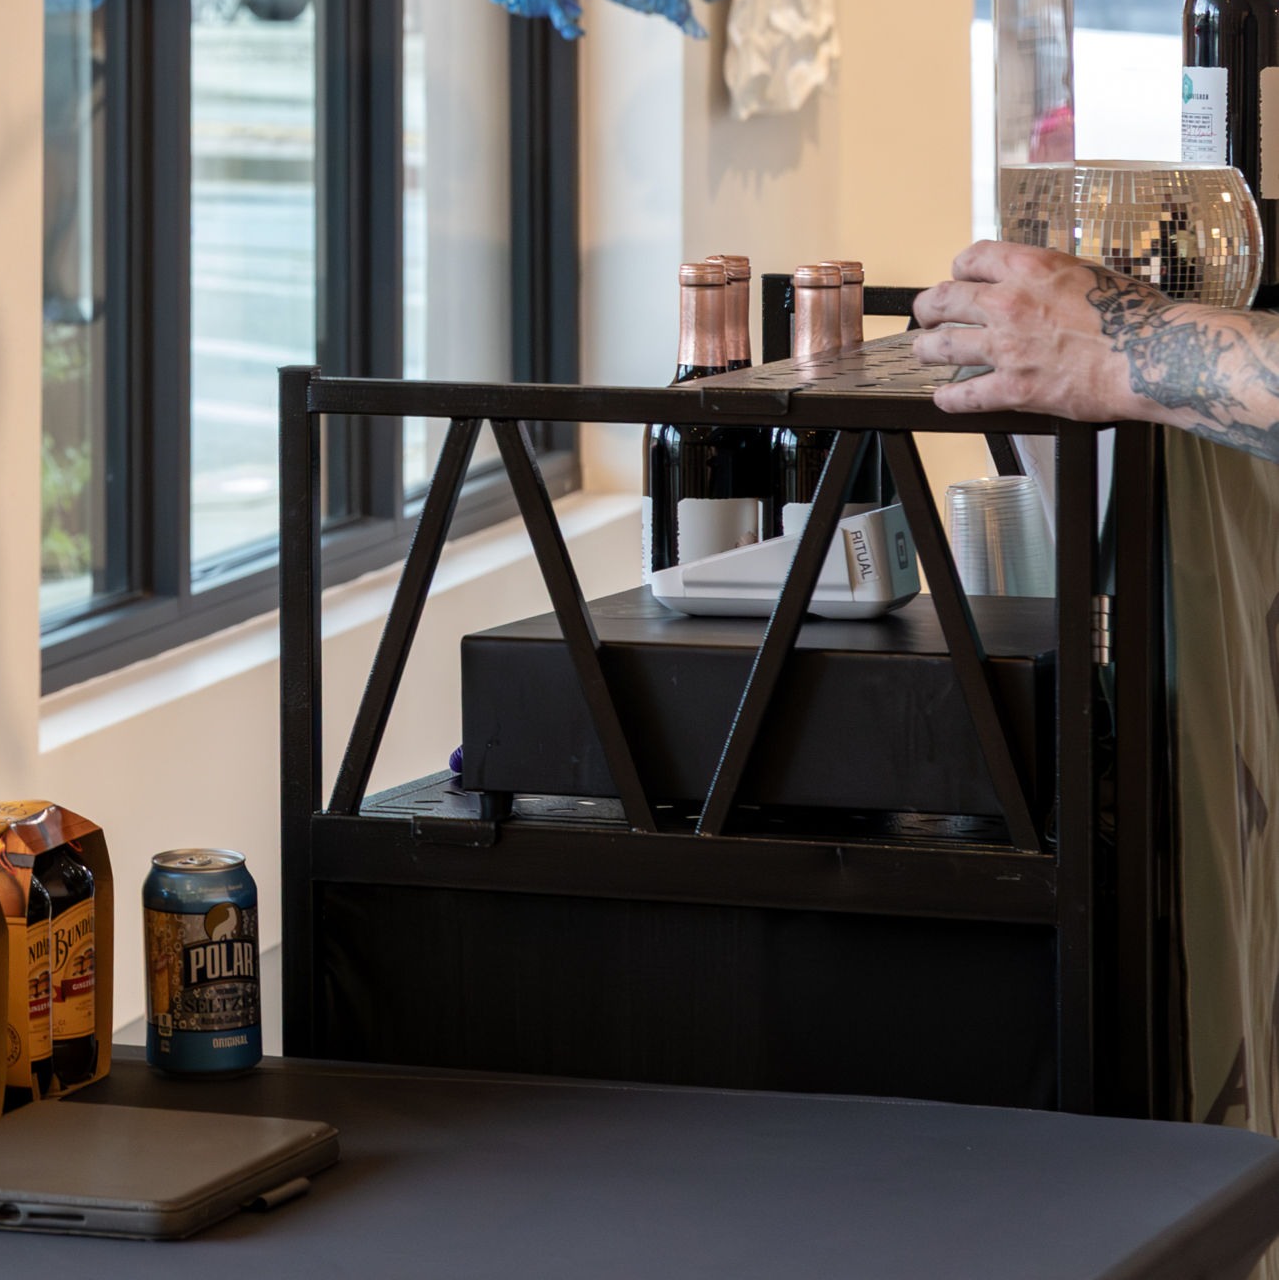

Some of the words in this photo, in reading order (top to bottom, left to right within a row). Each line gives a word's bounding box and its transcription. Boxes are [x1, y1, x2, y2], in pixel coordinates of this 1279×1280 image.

[850, 529, 873, 580] RITUAL
[190, 941, 255, 983] POLAR
[212, 1034, 249, 1049] ORIGINAL
